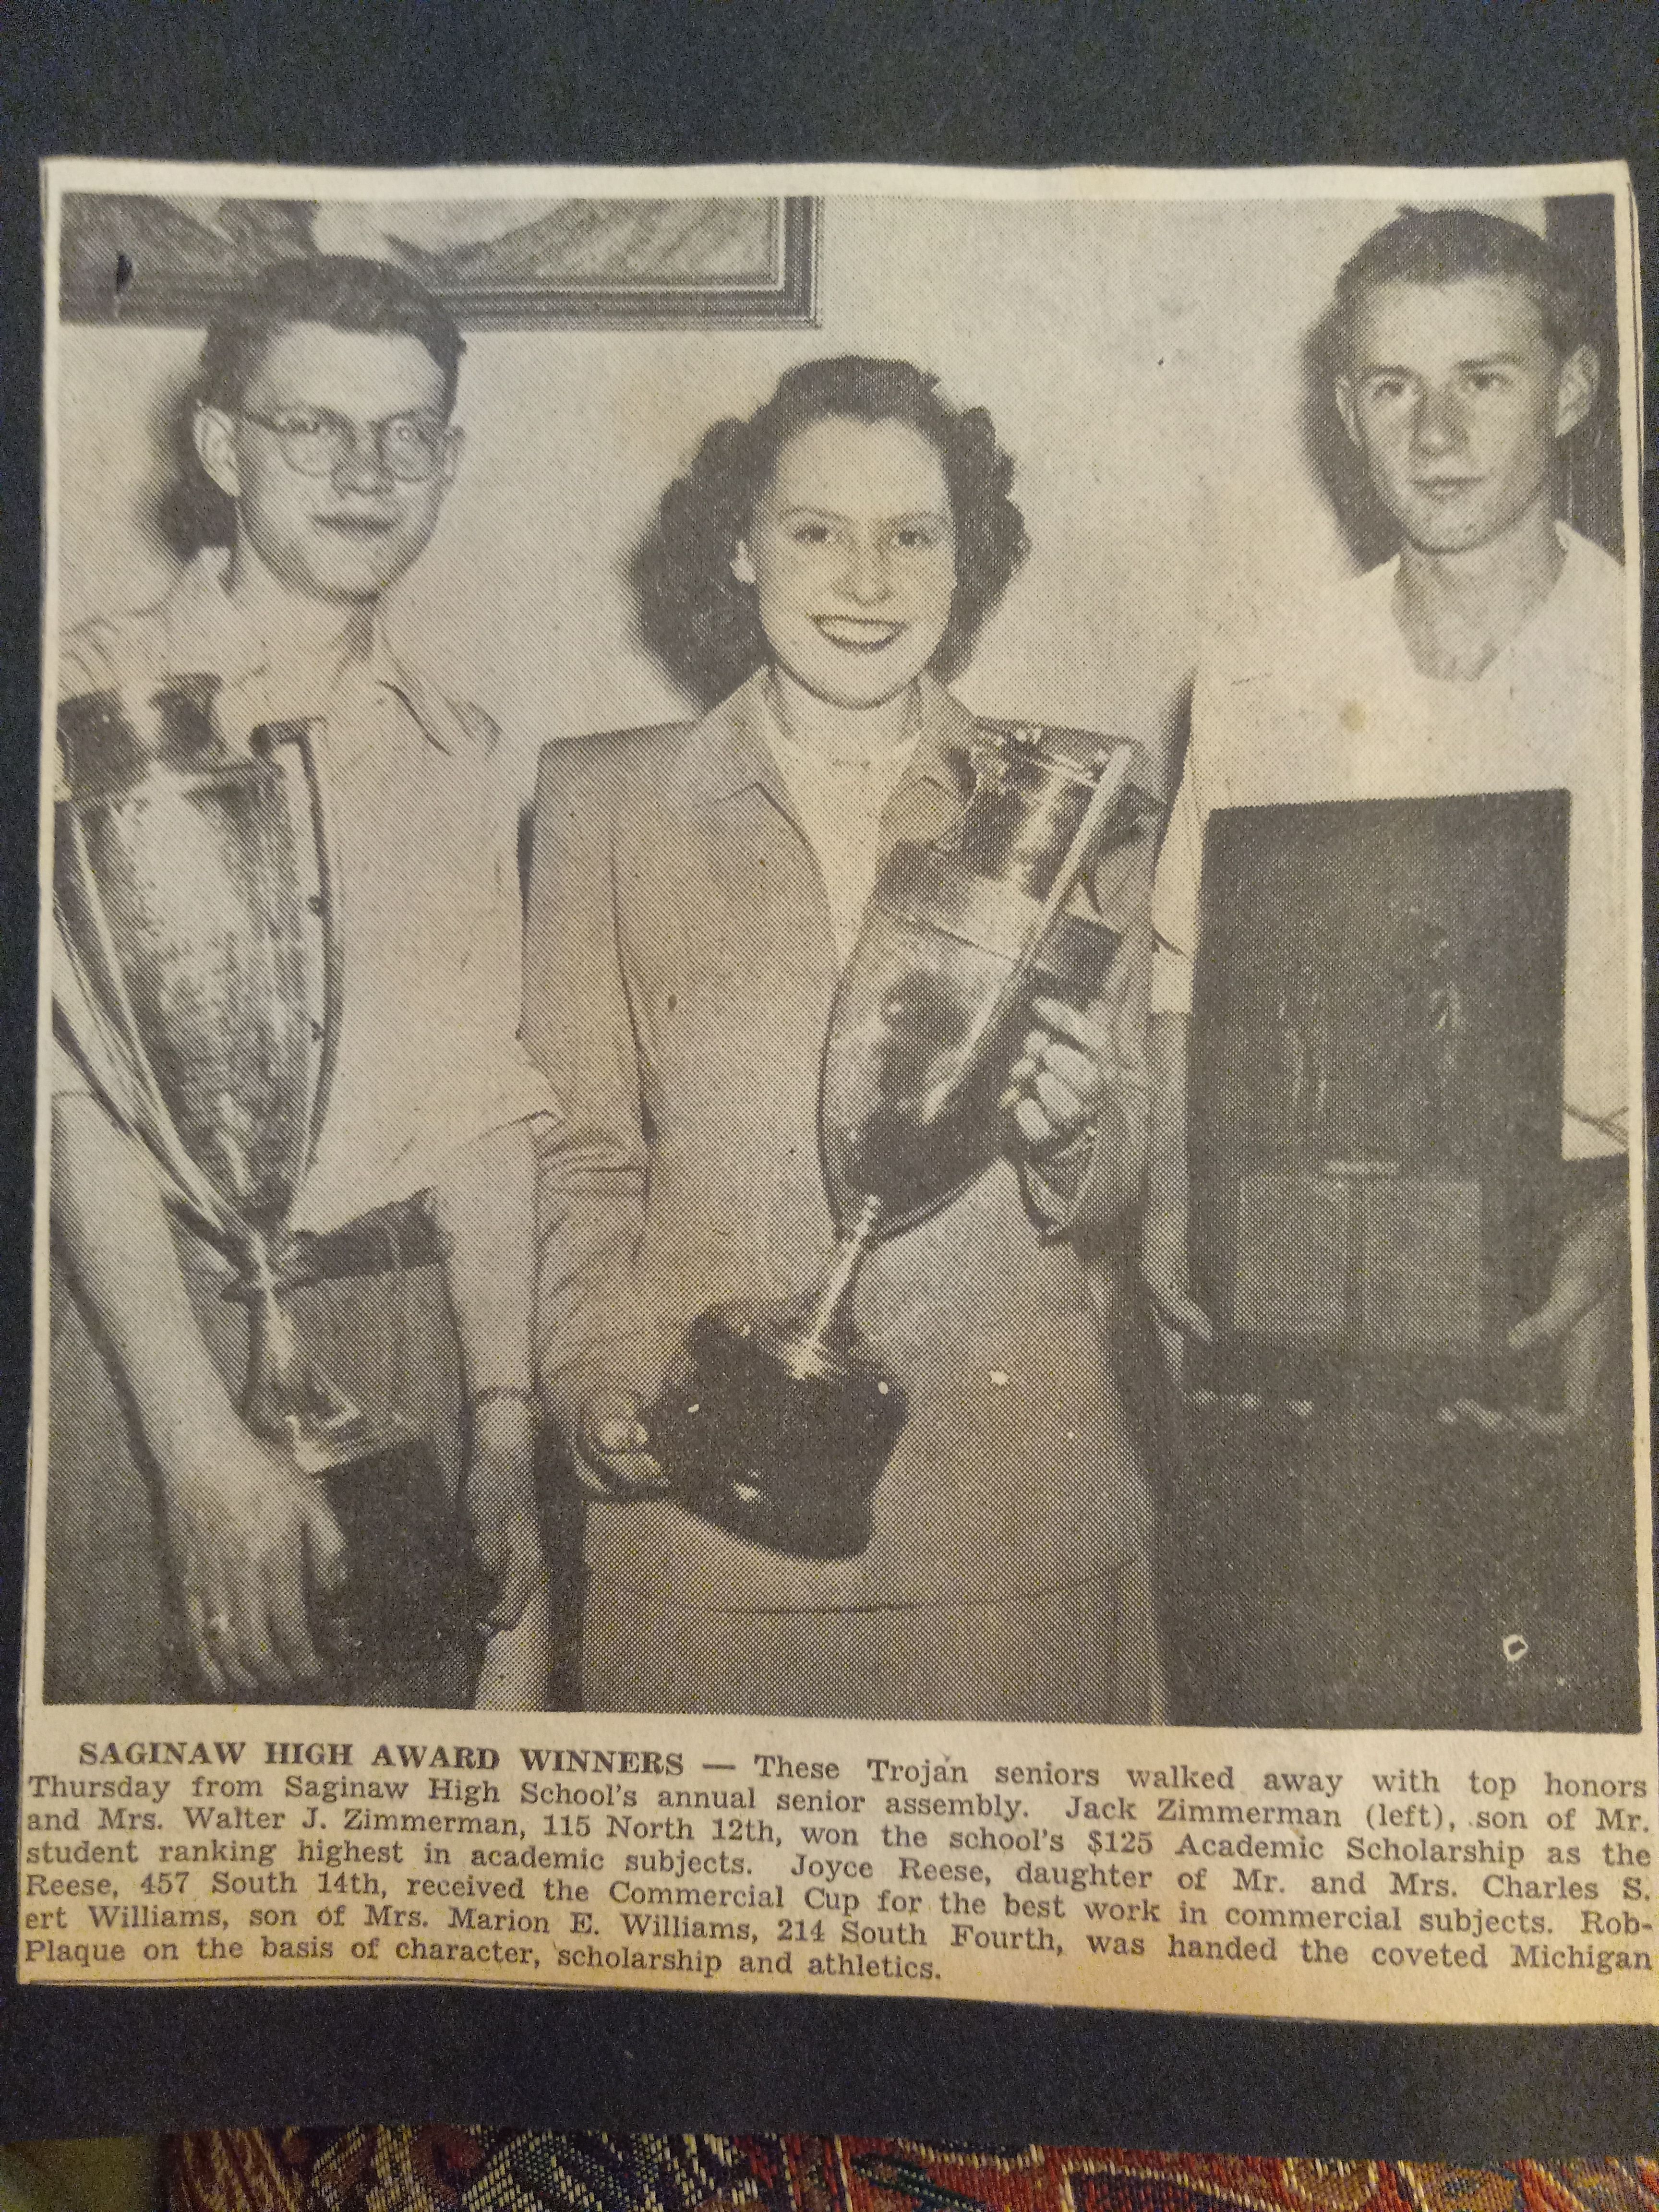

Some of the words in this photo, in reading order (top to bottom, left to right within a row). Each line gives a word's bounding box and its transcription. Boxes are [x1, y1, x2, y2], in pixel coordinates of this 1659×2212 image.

[79, 1741, 246, 1765] SAGINAW
[264, 1742, 353, 1766] HIGH
[371, 1744, 500, 1770] AWARD
[519, 1748, 684, 1776] WINNERS
[754, 1754, 840, 1779] These
[866, 1755, 968, 1788] Trojan
[995, 1761, 1099, 1787] seniors
[1126, 1765, 1235, 1790] walked
[1263, 1772, 1343, 1798] away
[1371, 1768, 1440, 1793] with
[1468, 1770, 1516, 1801] top
[1544, 1771, 1647, 1798] honors
[29, 1775, 170, 1803] Thursday
[192, 1775, 263, 1797] from
[285, 1776, 409, 1803] Saginaw
[428, 1778, 500, 1807] High
[658, 1787, 756, 1809] annual
[776, 1790, 866, 1813] senior
[885, 1793, 1028, 1823] assembly.
[1065, 1796, 1136, 1820] Jack
[1157, 1799, 1341, 1827] Zimmerman
[1366, 1803, 1455, 1832] (left),
[1477, 1811, 1528, 1829] son
[1547, 1808, 1576, 1831] of
[1596, 1807, 1649, 1833] Mr.
[29, 1808, 80, 1831] and
[97, 1808, 163, 1830] Mrs.
[183, 1806, 286, 1830] Walter
[302, 1807, 326, 1829] J.
[344, 1808, 525, 1840] Zimmerman,
[544, 1814, 591, 1837] 115
[606, 1815, 695, 1840] North
[712, 1818, 782, 1848] 12th,
[800, 1827, 859, 1847] won
[881, 1825, 927, 1848] the
[1087, 1830, 1153, 1856] $125
[1175, 1833, 1323, 1860] Academic
[1346, 1837, 1525, 1870] Scholarship
[1547, 1846, 1581, 1865] as
[1602, 1842, 1651, 1867] the
[28, 1840, 139, 1863] student
[159, 1839, 277, 1866] ranking
[297, 1839, 404, 1867] highest
[424, 1842, 451, 1865] in
[471, 1845, 604, 1871] academic
[625, 1850, 752, 1878] subjects.
[791, 1853, 873, 1883] Joyce
[899, 1857, 991, 1887] Reese,
[1015, 1861, 1153, 1891] daughter
[1177, 1868, 1207, 1891] of
[1233, 1868, 1285, 1893] Mr.
[1311, 1871, 1366, 1895] and
[1389, 1871, 1457, 1898] Mrs.
[1483, 1874, 1599, 1900] Charles
[1623, 1876, 1650, 1901] S.
[27, 1875, 118, 1899] Reese,
[140, 1871, 189, 1894] 457
[211, 1871, 297, 1894] South
[318, 1872, 386, 1899] 14th,
[407, 1875, 525, 1900] received
[543, 1878, 589, 1902] the
[609, 1880, 784, 1909] Commercial
[804, 1887, 860, 1917] Cup
[878, 1889, 922, 1915] for
[939, 1892, 986, 1915] the
[1003, 1892, 1066, 1919] best
[1084, 1899, 1160, 1923] work
[1179, 1900, 1207, 1925] in
[1226, 1905, 1402, 1931] commercial
[1419, 1908, 1553, 1937] subjects.
[1580, 1910, 1652, 1935] Rob-
[26, 1940, 125, 1967] Plaque
[143, 1943, 179, 1961] on
[196, 1937, 243, 1960] the
[261, 1936, 333, 1958] basis
[350, 1937, 380, 1960] of
[396, 1937, 540, 1969] character,
[558, 1946, 722, 1978] scholarship
[739, 1951, 793, 1974] and
[807, 1953, 941, 1980] athletics.
[27, 1907, 67, 1929] ert
[88, 1905, 228, 1930] Williams,
[249, 1909, 297, 1926] son
[318, 1904, 346, 1927] of
[364, 1904, 428, 1927] Mrs.
[448, 1907, 550, 1934] Marion
[570, 1912, 599, 1936] E.
[620, 1912, 758, 1945] Williams,
[777, 1919, 825, 1942] 214
[842, 1921, 927, 1946] South
[950, 1924, 1063, 1957] Fourth,
[1086, 1935, 1145, 1956] was
[1167, 1934, 1277, 1961] handed
[1300, 1939, 1348, 1965] the
[1371, 1943, 1488, 1969] coveted
[1511, 1945, 1653, 1975] Michigan
